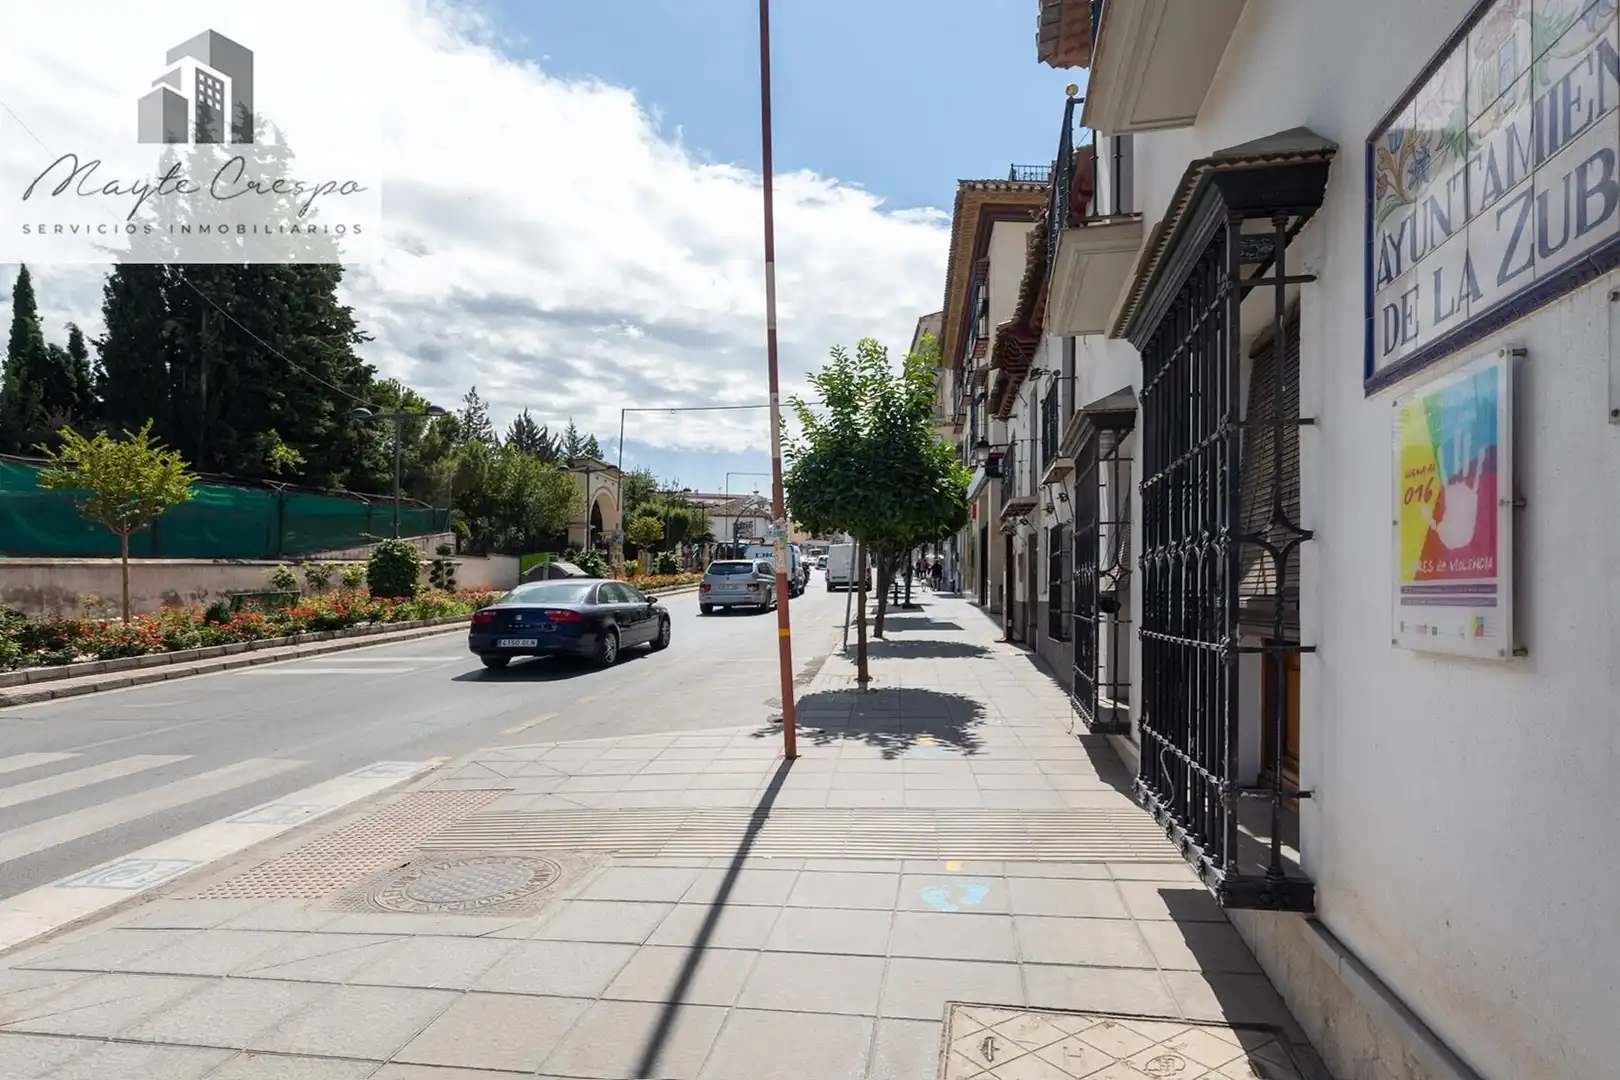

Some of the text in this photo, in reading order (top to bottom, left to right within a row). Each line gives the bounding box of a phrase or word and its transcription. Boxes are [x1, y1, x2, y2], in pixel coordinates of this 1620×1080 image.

[1382, 283, 1420, 358] DE
[1433, 248, 1484, 327] LA
[1404, 476, 1434, 505] 016
[1449, 556, 1493, 573] VIOLENCIA
